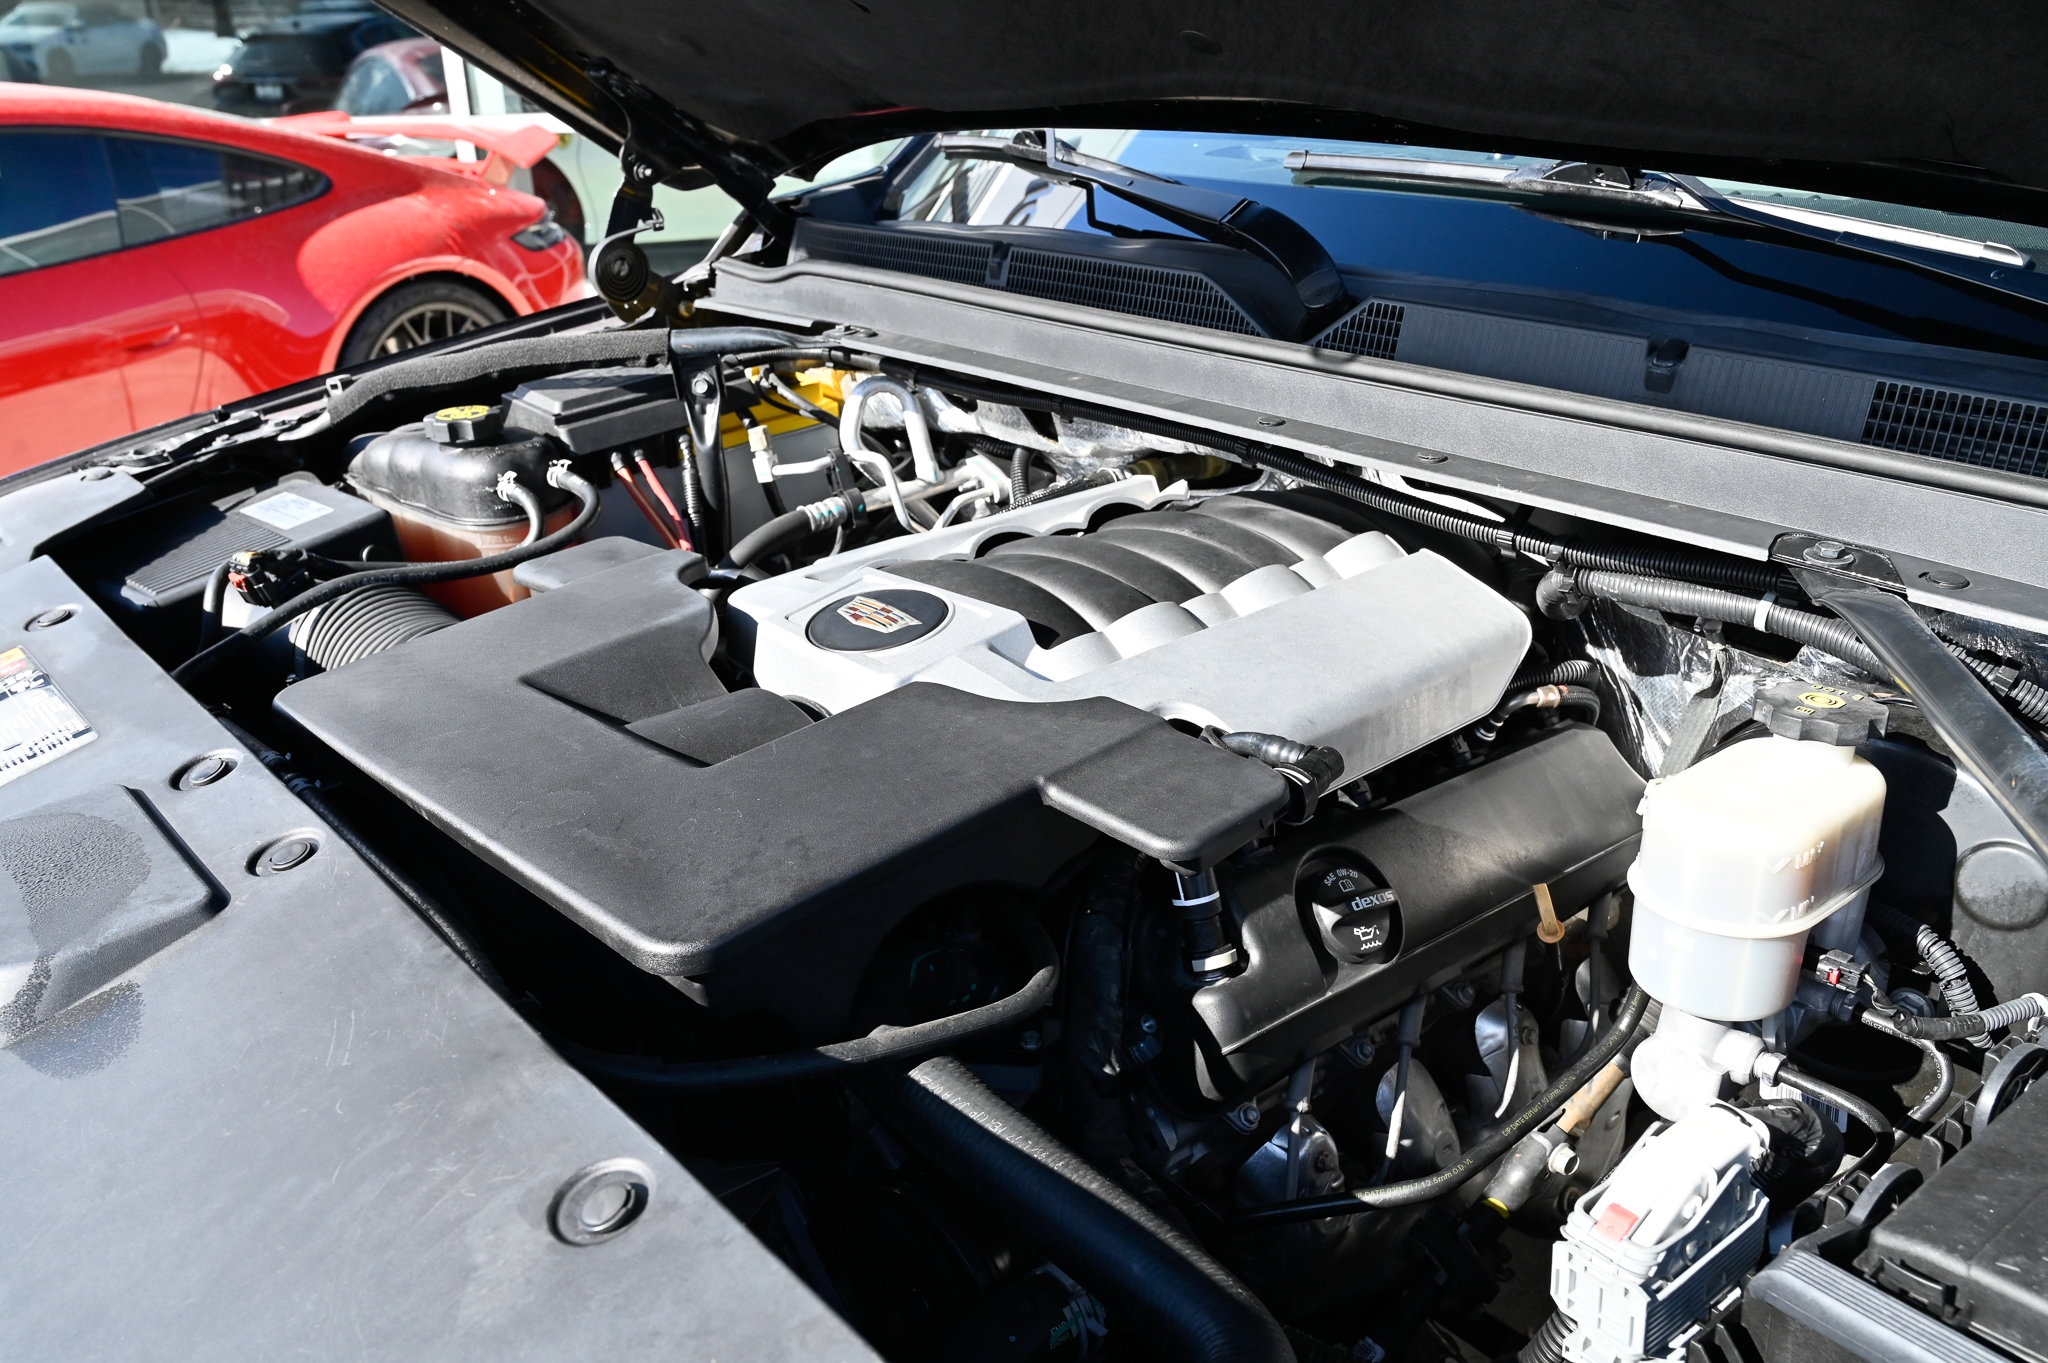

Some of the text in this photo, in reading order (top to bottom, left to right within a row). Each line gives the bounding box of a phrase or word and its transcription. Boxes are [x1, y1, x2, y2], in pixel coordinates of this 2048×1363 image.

[1323, 868, 1358, 886] SAE 0W-20
[1351, 890, 1395, 912] dexos
[1511, 1116, 1525, 1130] DATE
[1364, 1188, 1385, 1197] DATE
[1422, 1172, 1453, 1187] 12.5mm
